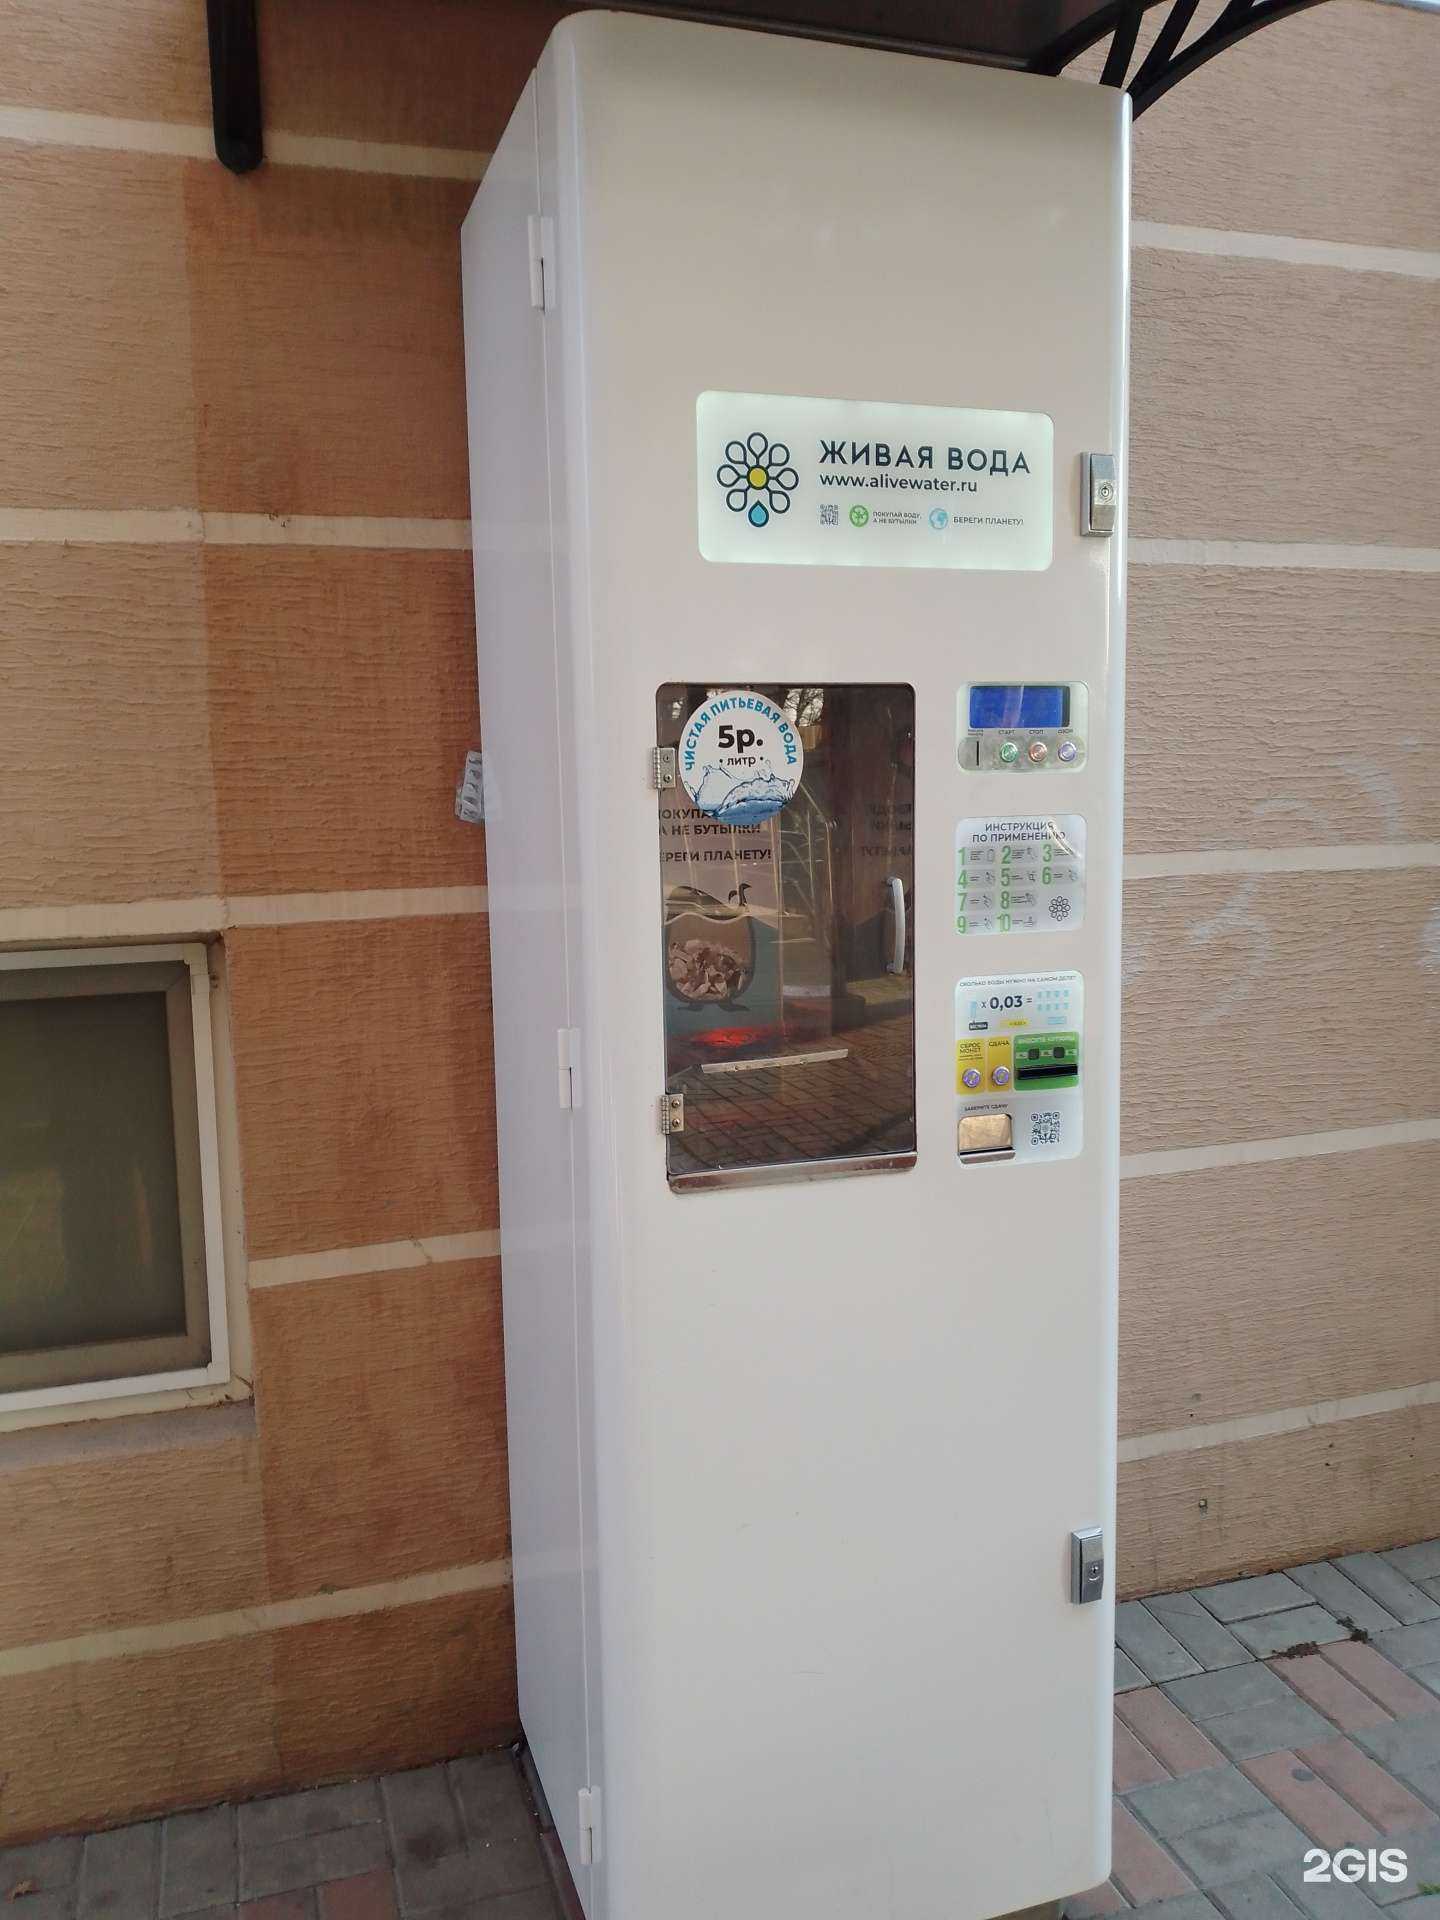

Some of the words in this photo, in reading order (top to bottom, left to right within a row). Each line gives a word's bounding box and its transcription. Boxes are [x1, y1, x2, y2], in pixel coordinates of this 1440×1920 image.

[819, 439, 933, 469] ЖИВАЯ
[948, 447, 1030, 477] ВОДА
[819, 473, 977, 492] www.alivewater.ru
[953, 516, 983, 524] БЕРЕГИ
[985, 517, 1024, 526] ПЛАНЕТУ!
[685, 711, 711, 771] ЧИСТАЯ
[709, 696, 781, 724] ПИТЬЕВАЯ
[777, 722, 797, 765] ВОДА
[717, 724, 764, 753] 5р.
[727, 756, 756, 767] литр
[659, 809, 711, 819] ОКУПА
[671, 825, 690, 835] НЕ
[972, 834, 987, 842] ПО
[660, 851, 700, 861] ЕРЕГИ
[958, 847, 966, 865] 1
[1001, 845, 1011, 864] 2
[1043, 844, 1052, 862] 3
[958, 869, 967, 888] 4
[1001, 868, 1010, 886] 5
[1042, 867, 1052, 885] 6
[957, 892, 967, 911] 7
[1001, 891, 1010, 909] 8
[957, 915, 966, 934] 9
[997, 914, 1010, 931] 10
[989, 995, 1023, 1011] 0,03
